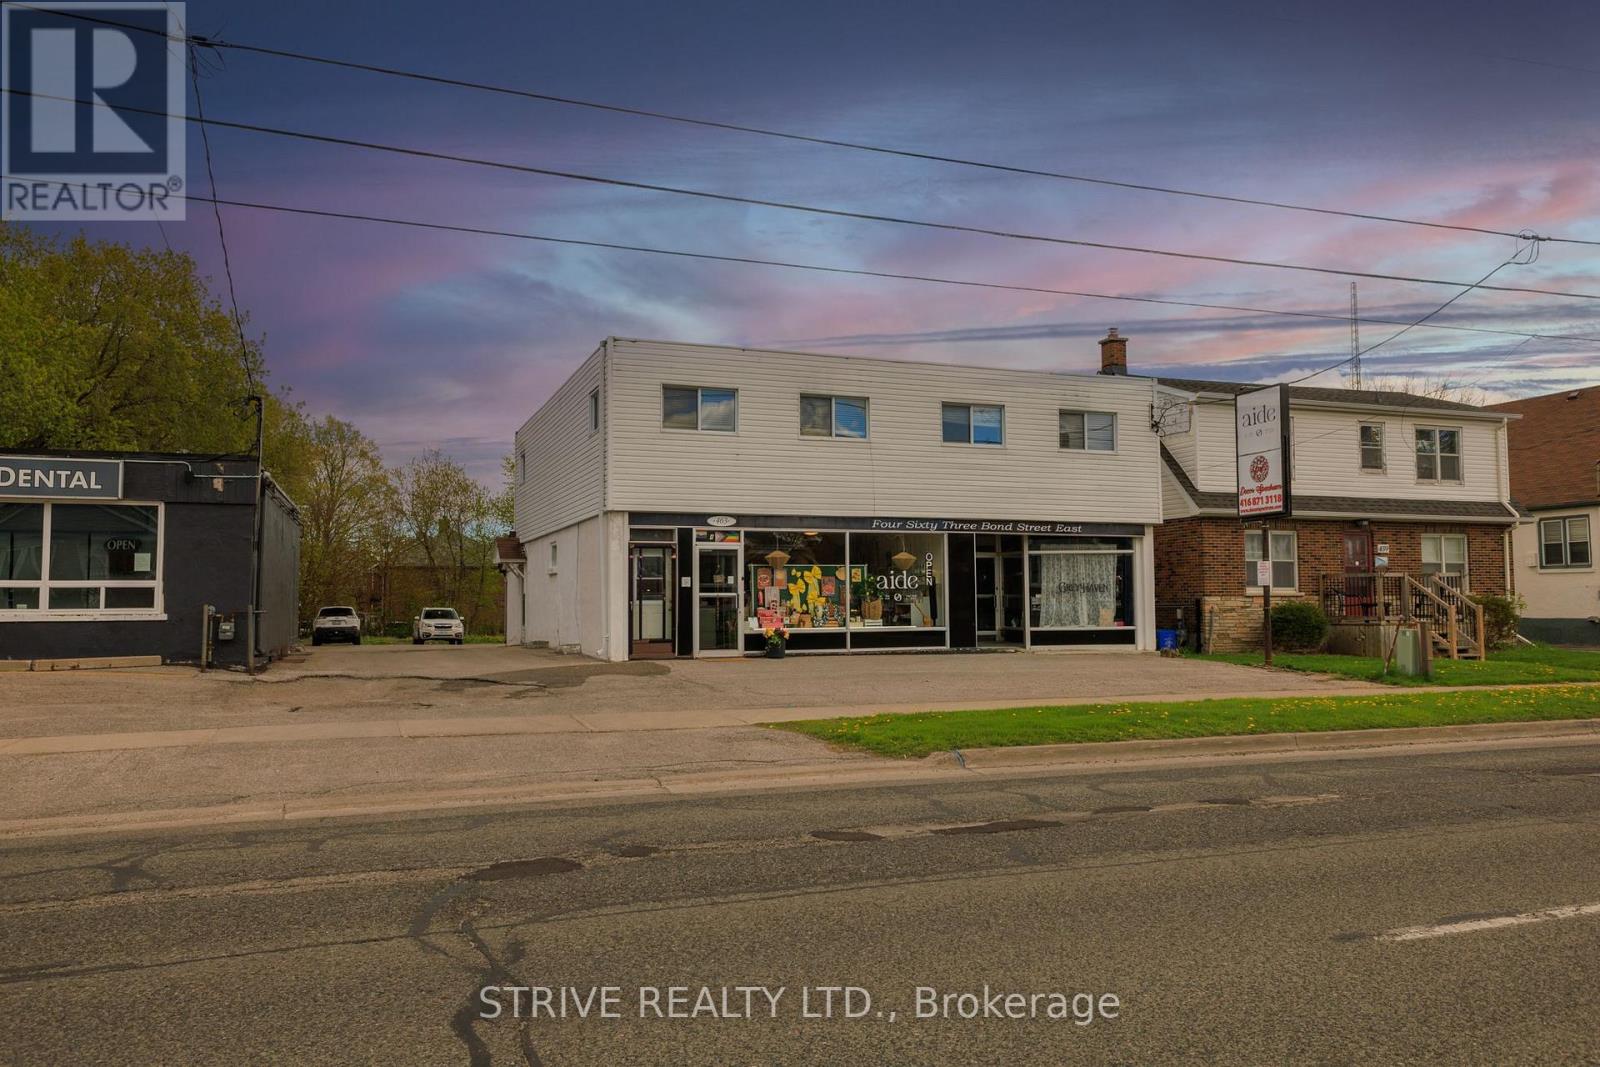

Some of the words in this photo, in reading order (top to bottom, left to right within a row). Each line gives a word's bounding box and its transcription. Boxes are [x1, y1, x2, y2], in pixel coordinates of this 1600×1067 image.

[1242, 404, 1276, 428] aide
[0, 466, 102, 490] DENTAL
[871, 519, 902, 530] Four
[905, 520, 938, 532] Sixty
[942, 521, 978, 531] Three
[980, 522, 1013, 532] Bond
[1016, 523, 1051, 533] Street
[1055, 524, 1083, 534] East
[106, 540, 136, 551] OPEN
[876, 569, 919, 590] aide
[925, 552, 934, 586] OPEN
